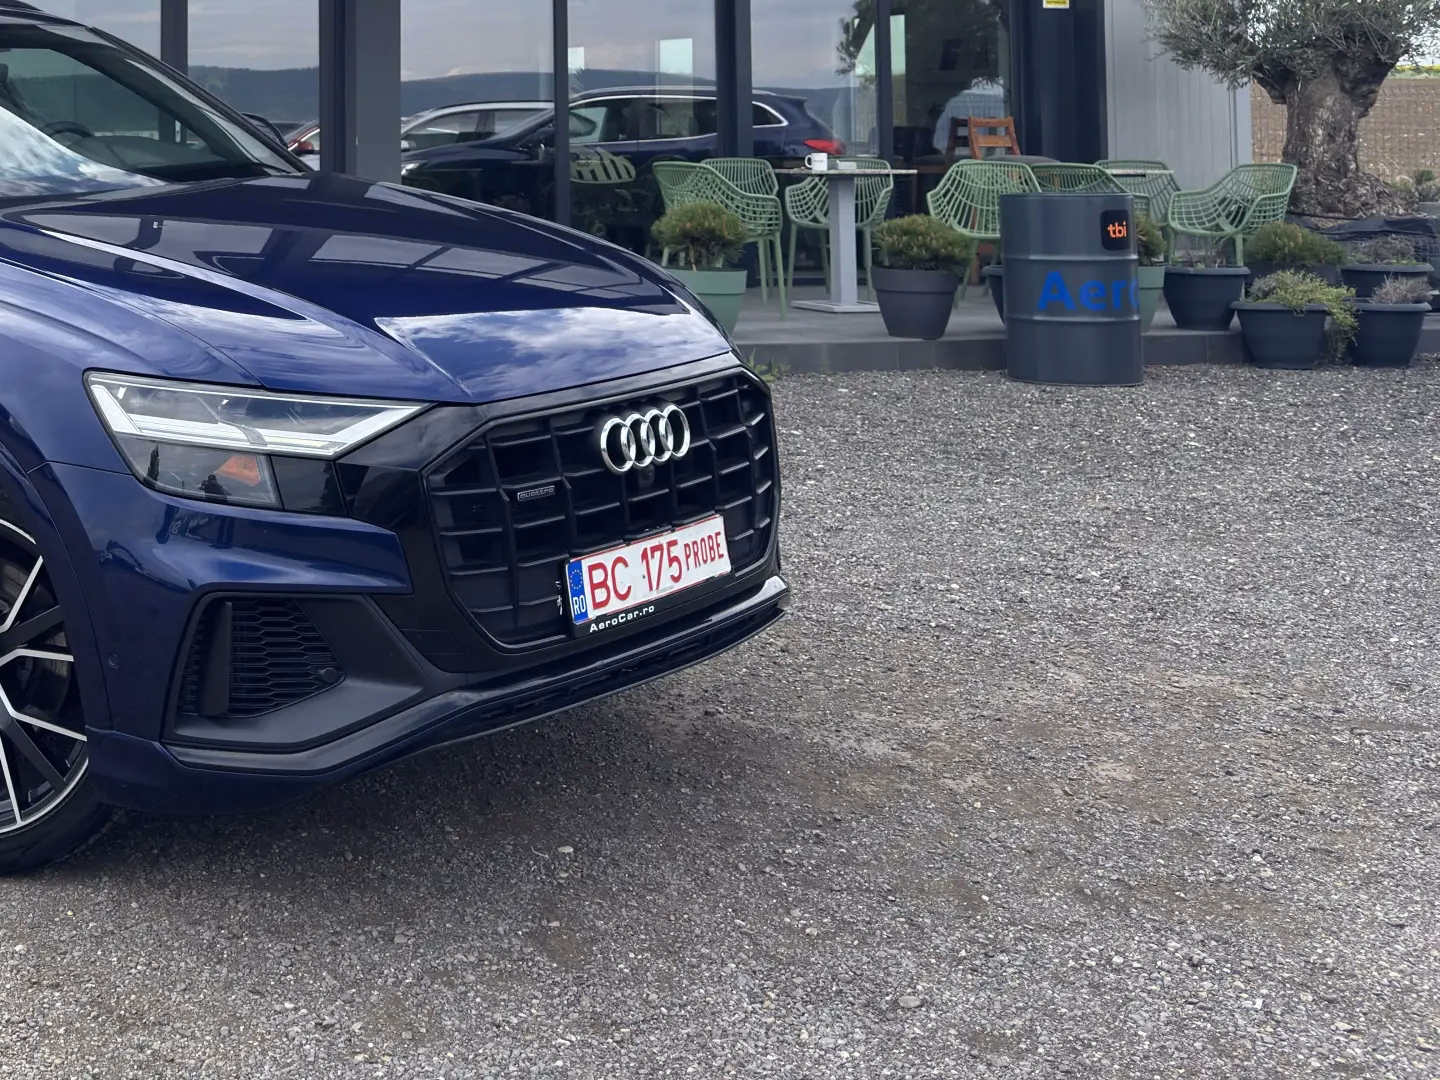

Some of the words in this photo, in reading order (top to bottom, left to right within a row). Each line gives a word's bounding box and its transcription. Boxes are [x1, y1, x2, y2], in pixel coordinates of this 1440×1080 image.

[1107, 220, 1127, 238] tbi
[587, 556, 632, 610] BC
[641, 539, 682, 592] 175
[684, 531, 724, 570] PROBE
[573, 594, 586, 615] RO
[589, 605, 655, 633] AeroCar.ro
